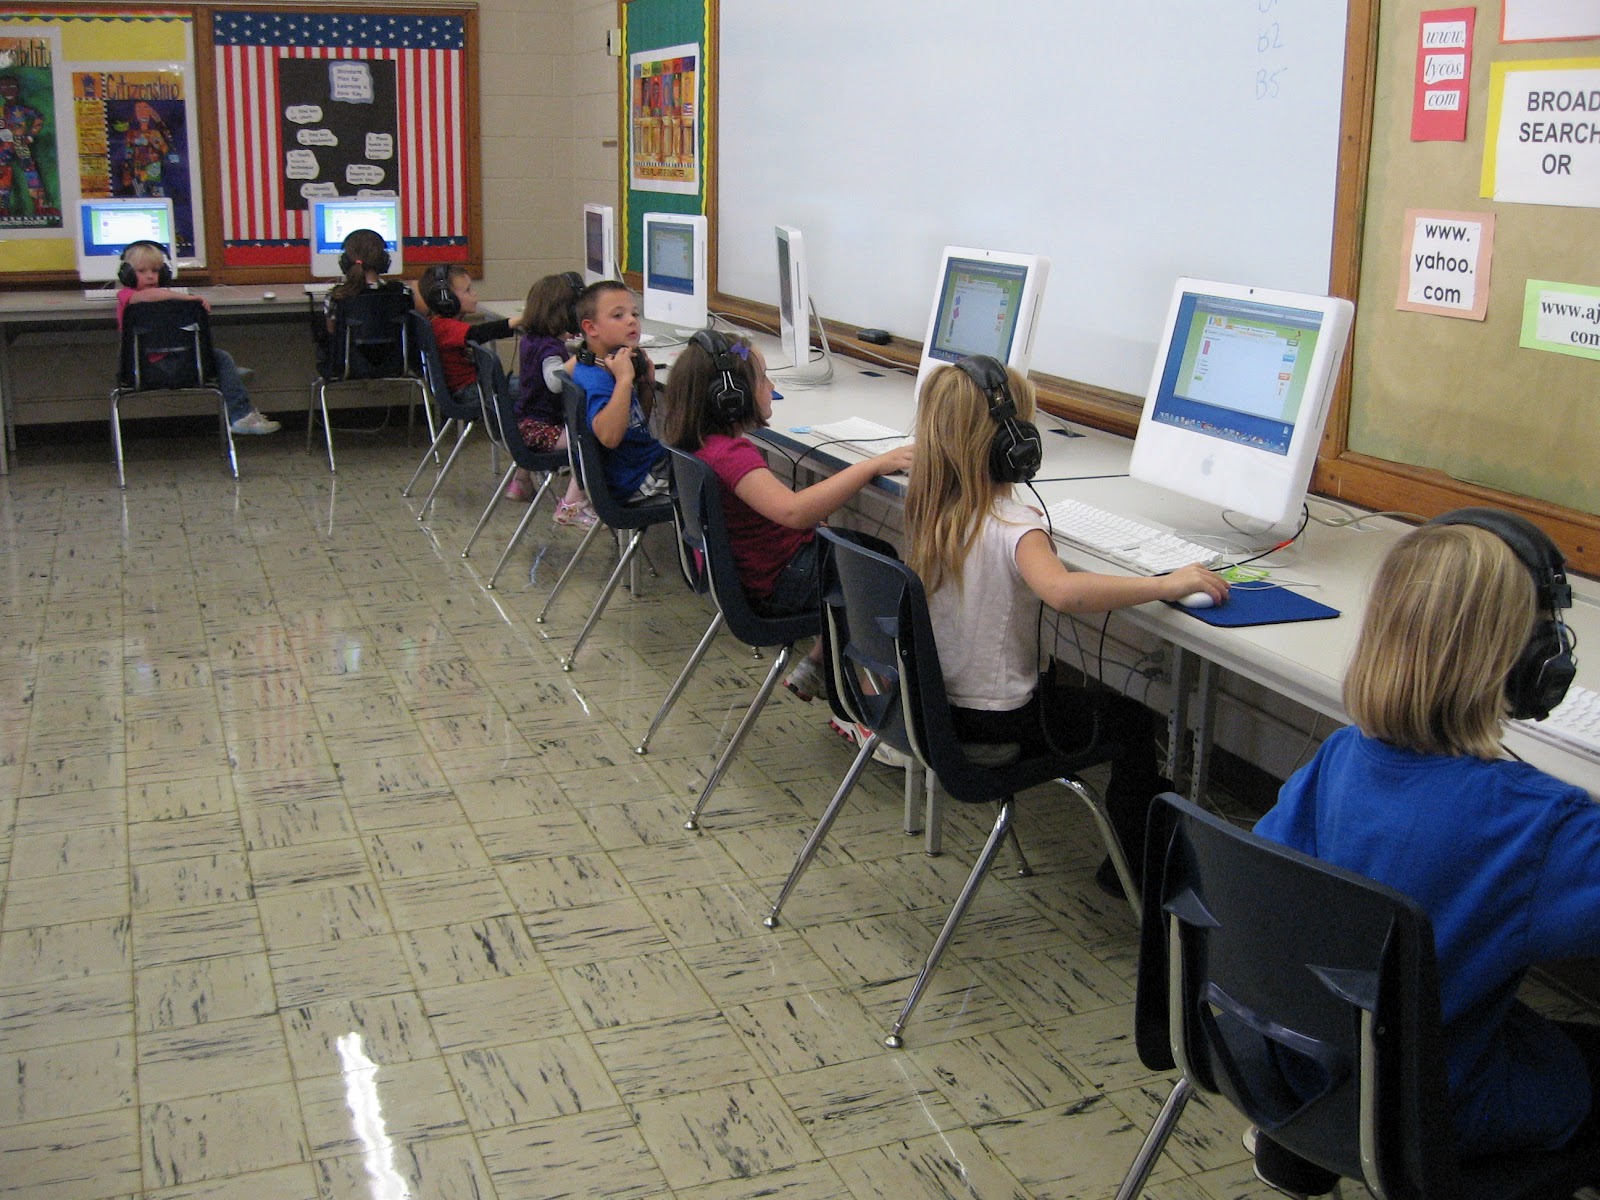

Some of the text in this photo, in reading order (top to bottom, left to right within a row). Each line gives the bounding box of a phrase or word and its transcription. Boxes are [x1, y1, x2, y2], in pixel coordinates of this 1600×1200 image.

[1425, 27, 1465, 44] www.
[1425, 57, 1462, 82] lycos.
[106, 73, 180, 100] Citizenship
[1428, 93, 1456, 106] com
[1527, 91, 1600, 112] BROAD
[1519, 122, 1600, 143] SEARCH
[1542, 154, 1571, 174] OR
[1425, 225, 1471, 242] www.
[1415, 252, 1473, 274] yahoo.
[1424, 286, 1461, 303] com
[1541, 302, 1600, 325] www.aj
